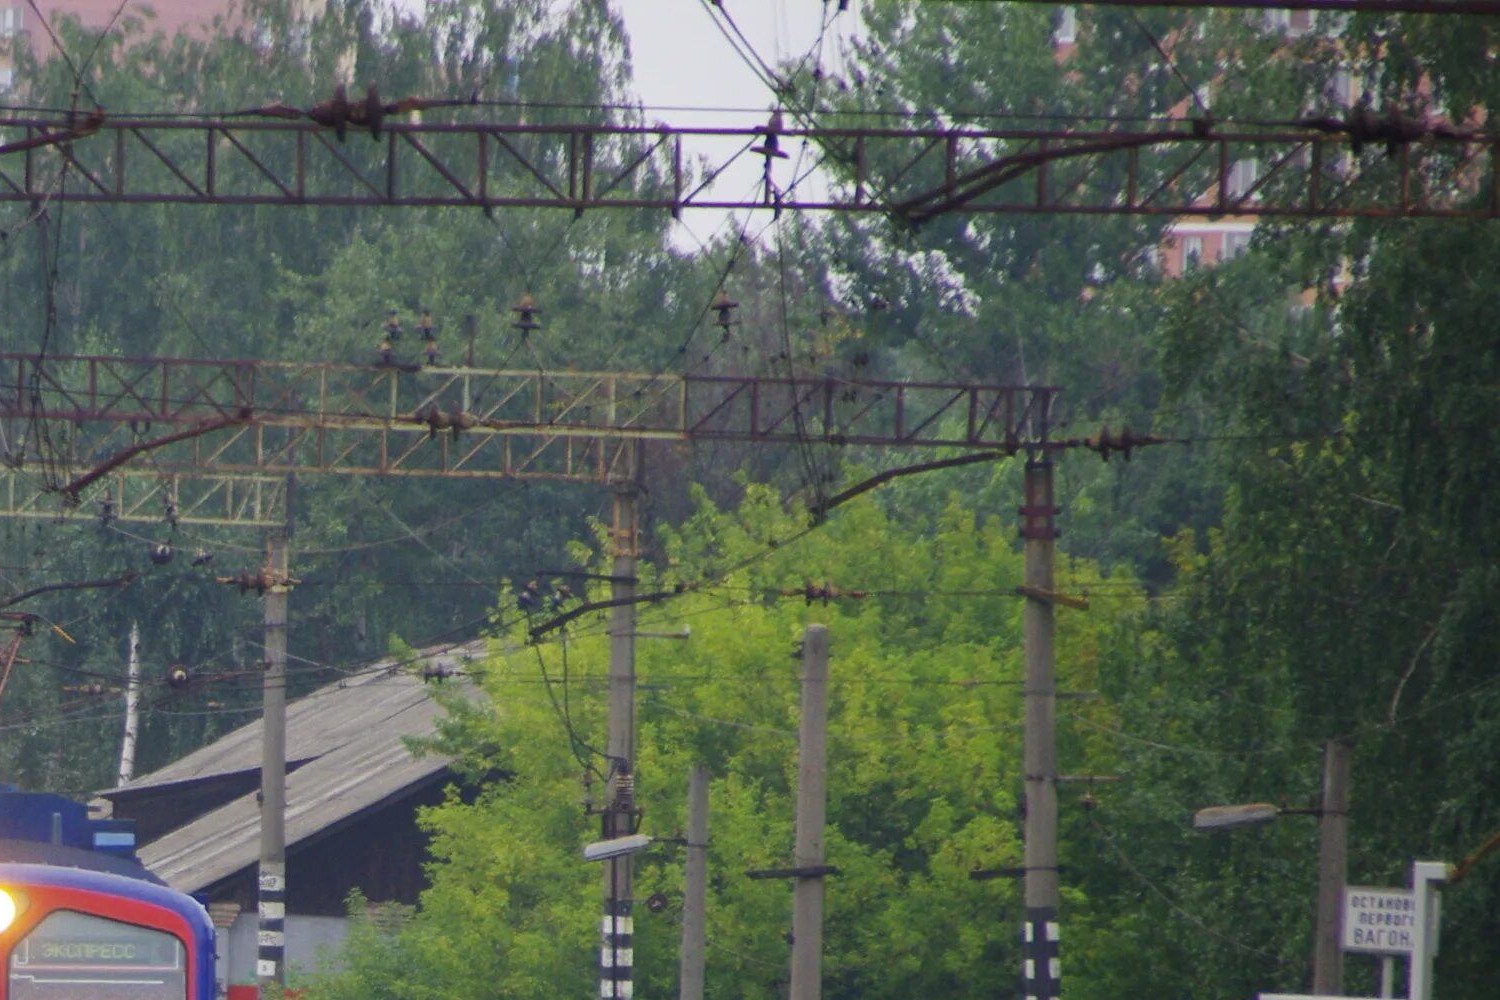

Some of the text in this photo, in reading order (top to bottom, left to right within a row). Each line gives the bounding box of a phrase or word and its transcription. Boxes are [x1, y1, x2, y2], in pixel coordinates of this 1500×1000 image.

[1352, 895, 1415, 911] ОСТАНОВ
[1353, 928, 1415, 947] ВАГОН
[41, 942, 137, 959] ЭКСПРЕСС
